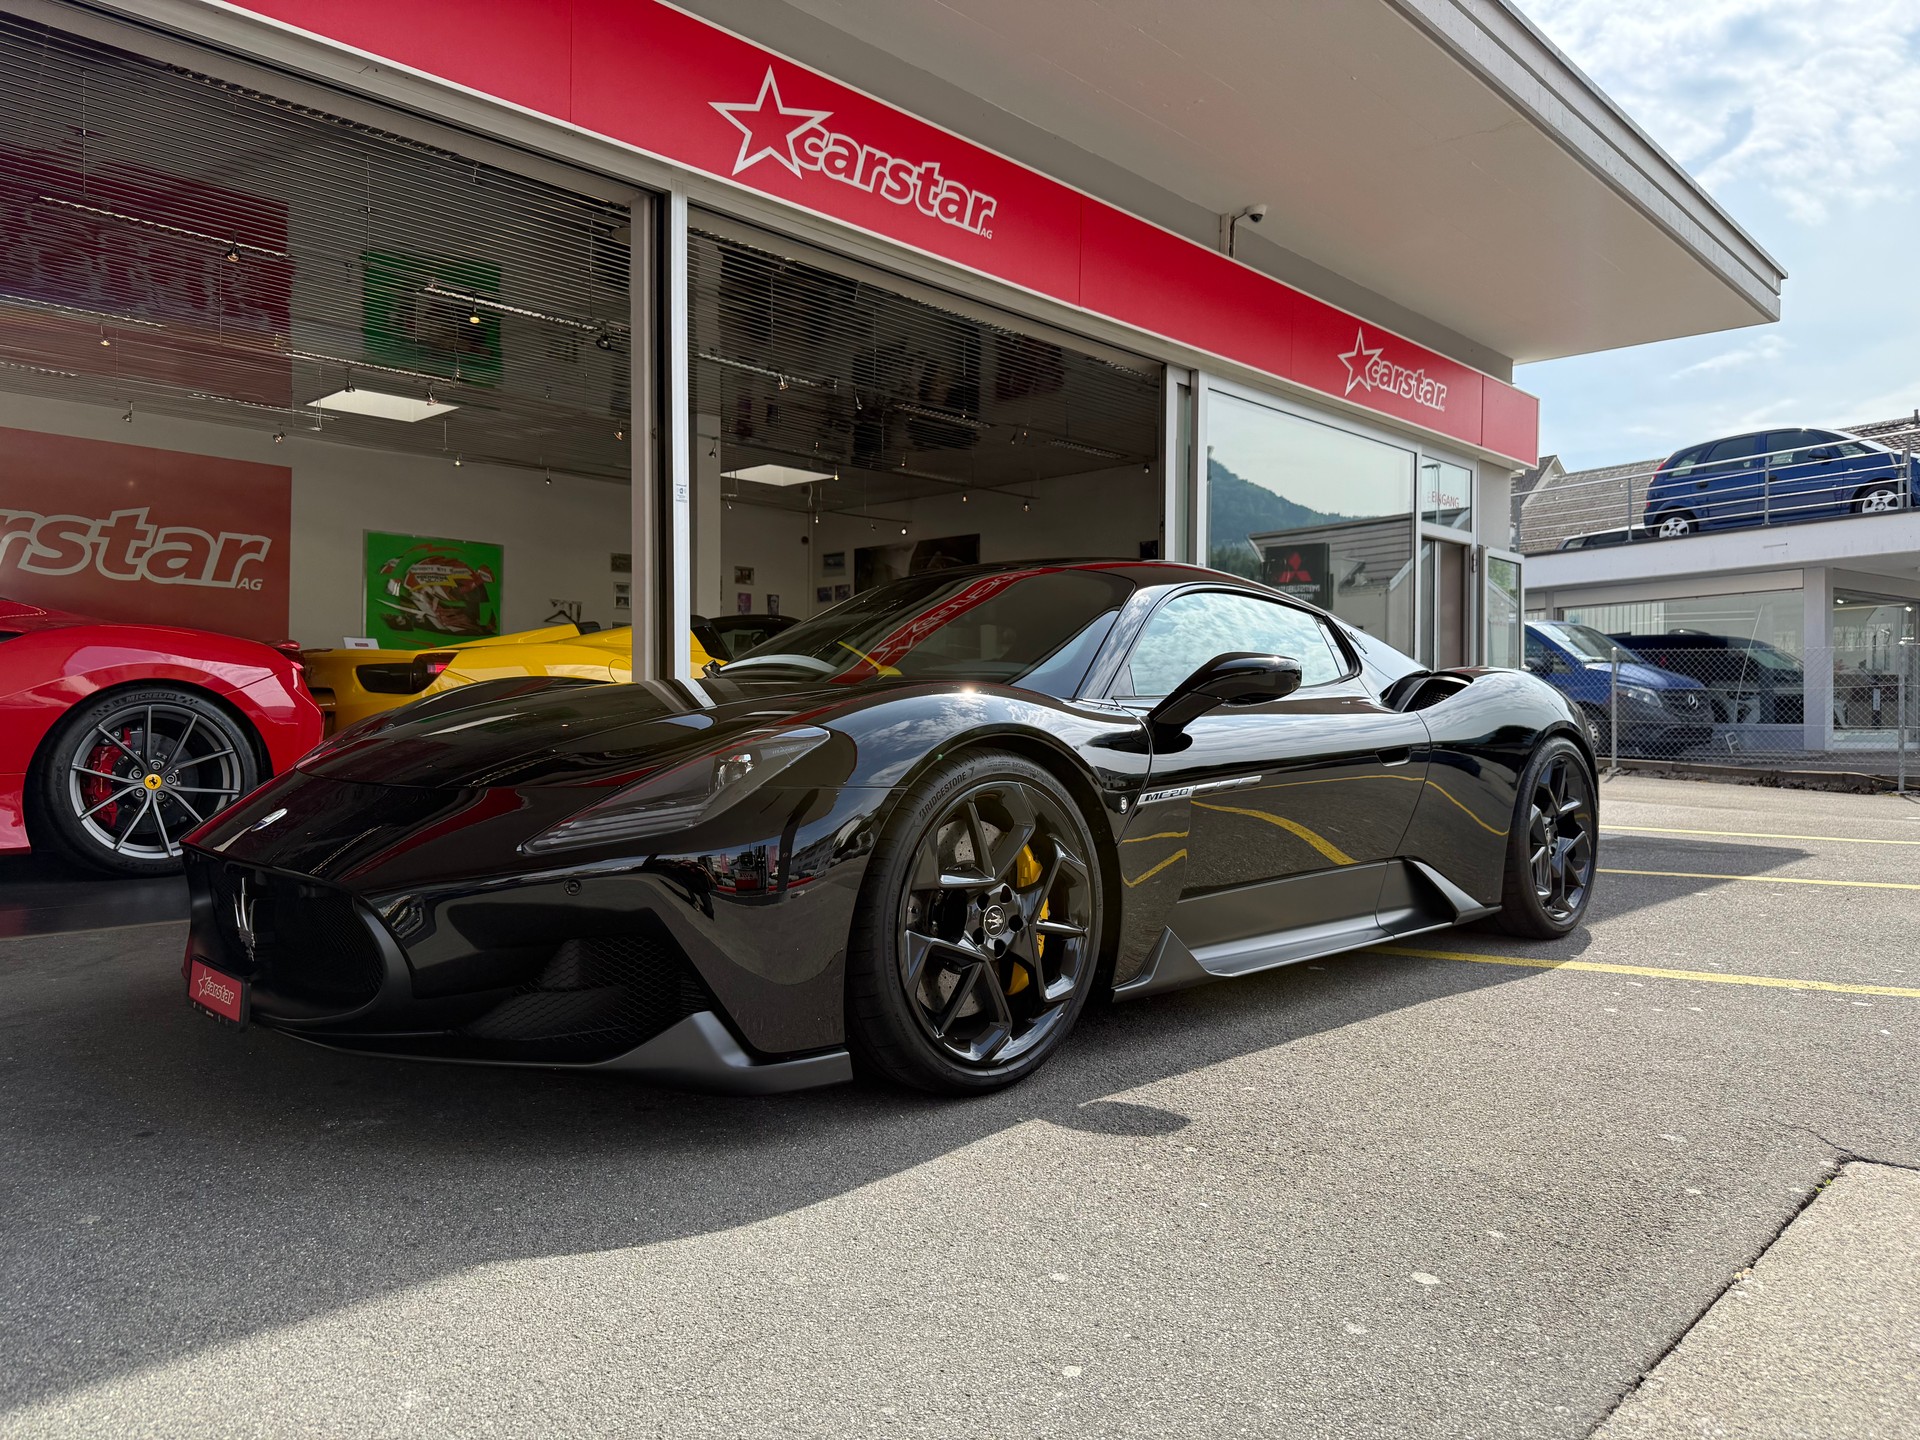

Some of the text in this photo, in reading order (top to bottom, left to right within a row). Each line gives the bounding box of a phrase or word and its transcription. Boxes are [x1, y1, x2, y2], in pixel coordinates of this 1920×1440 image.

[792, 124, 998, 240] carstar AG
[1365, 357, 1448, 411] carstar
[237, 578, 263, 590] AG
[125, 692, 176, 703] MICHELIN
[919, 771, 967, 820] BRIDGESTONE
[1144, 788, 1190, 801] MC20
[205, 980, 235, 1006] carstar
